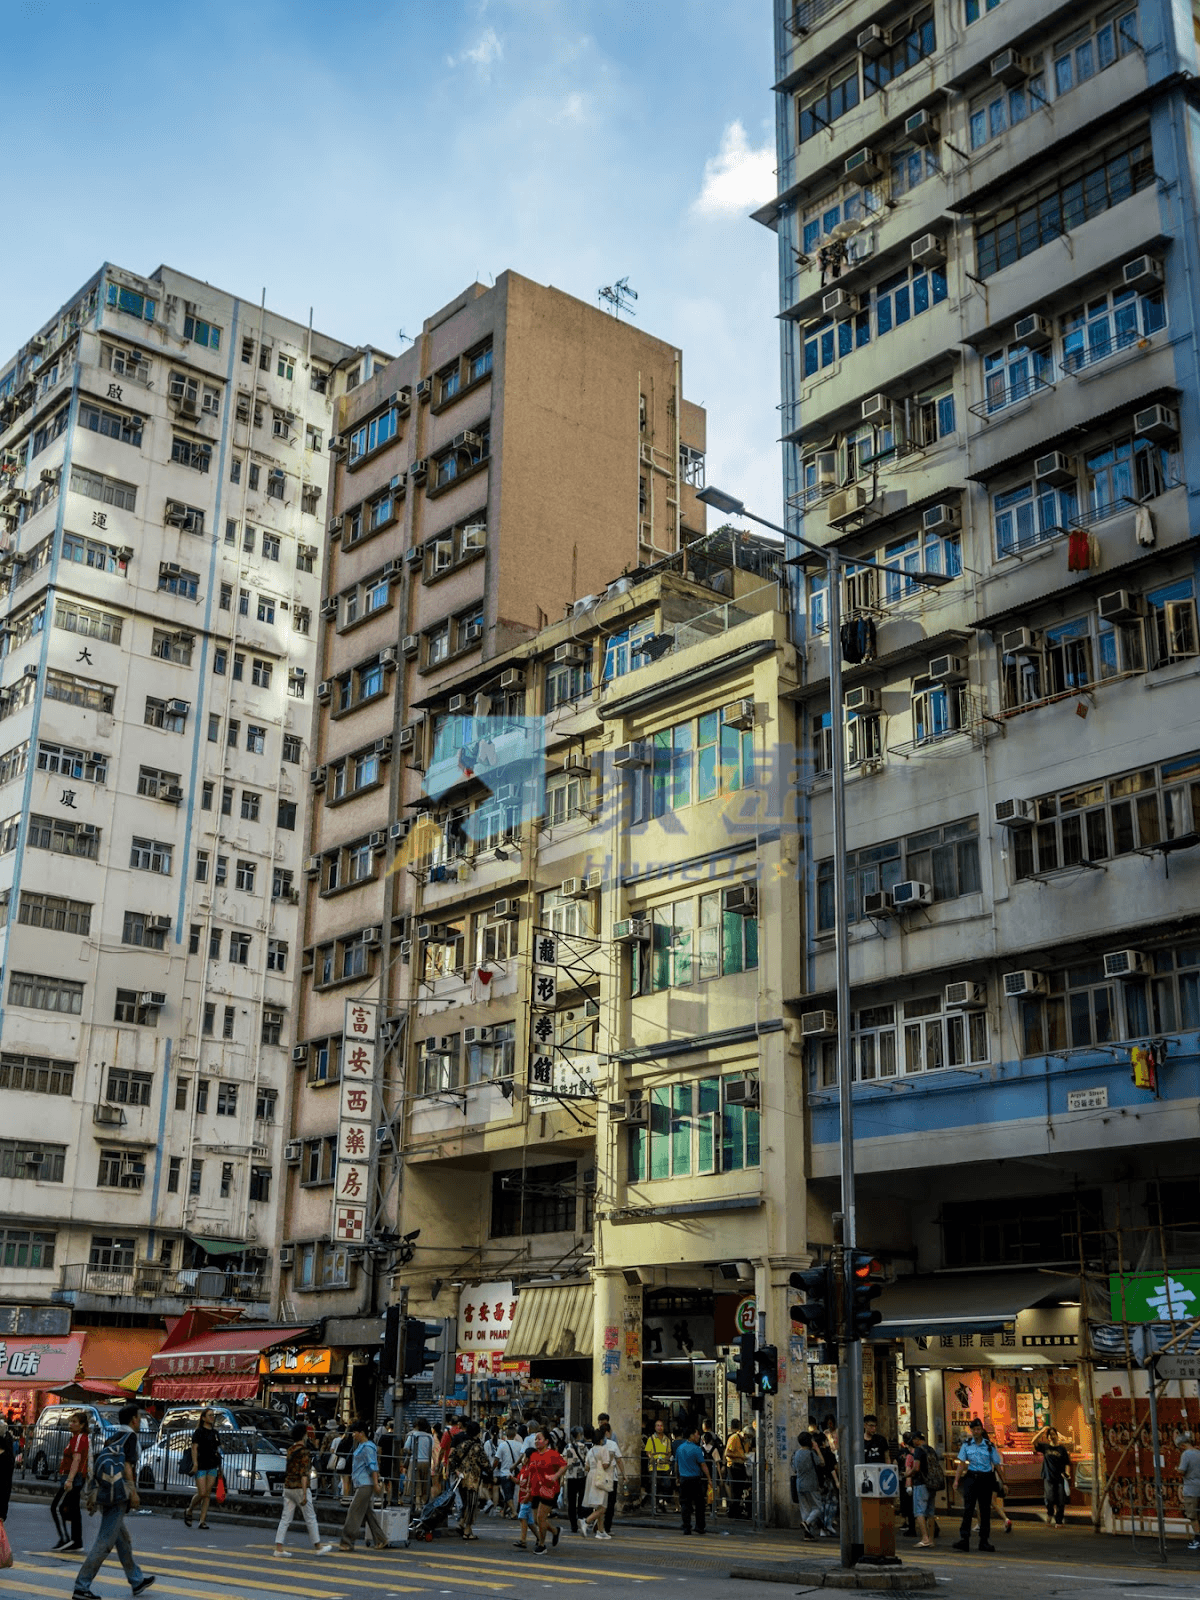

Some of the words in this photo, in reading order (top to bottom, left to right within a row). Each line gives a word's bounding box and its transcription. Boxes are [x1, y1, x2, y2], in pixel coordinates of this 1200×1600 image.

[341, 1005, 372, 1198] 富安西藥房
[1073, 1097, 1102, 1108] 亞皆老街
[464, 1330, 473, 1341] FU
[477, 1330, 486, 1340] ON
[1176, 1358, 1195, 1366] Argyle
